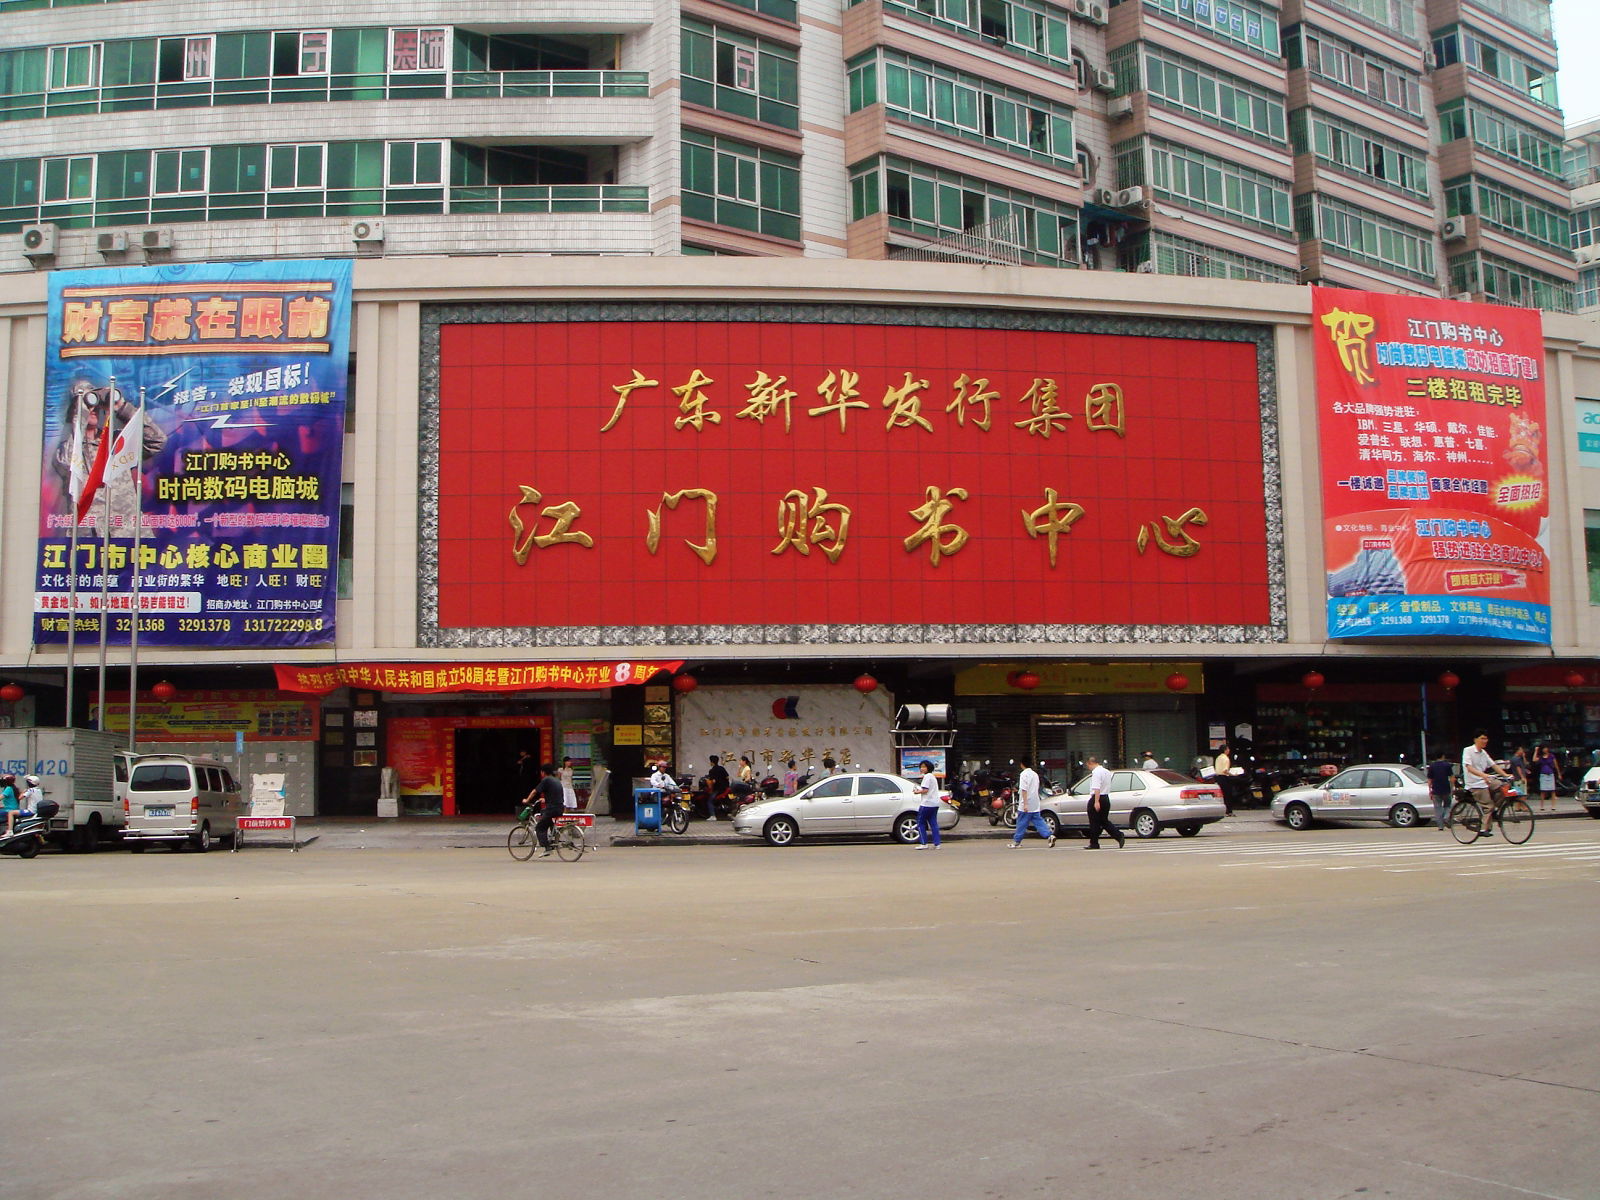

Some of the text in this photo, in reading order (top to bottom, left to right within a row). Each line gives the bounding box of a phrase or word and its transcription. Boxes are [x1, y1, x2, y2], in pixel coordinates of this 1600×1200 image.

[394, 30, 445, 69] 装饰
[61, 296, 331, 344] 财富就在眼前
[1408, 318, 1504, 347] 江门购书中心
[1321, 307, 1375, 385] 贺
[600, 368, 1126, 439] 广东新华发行集团
[1407, 377, 1523, 408] 二楼招租完毕
[186, 452, 291, 472] 江门购书中心
[158, 475, 319, 501] 时尚数码电脑城
[1497, 482, 1541, 504] 全面热招
[508, 485, 1208, 568] 江门购书中心
[1415, 518, 1492, 539] 江门购书中心
[43, 543, 328, 570] 江门市中心核心商业圈
[41, 618, 100, 632] 财富热线
[116, 618, 165, 632] 321368
[178, 618, 231, 632] 3291378
